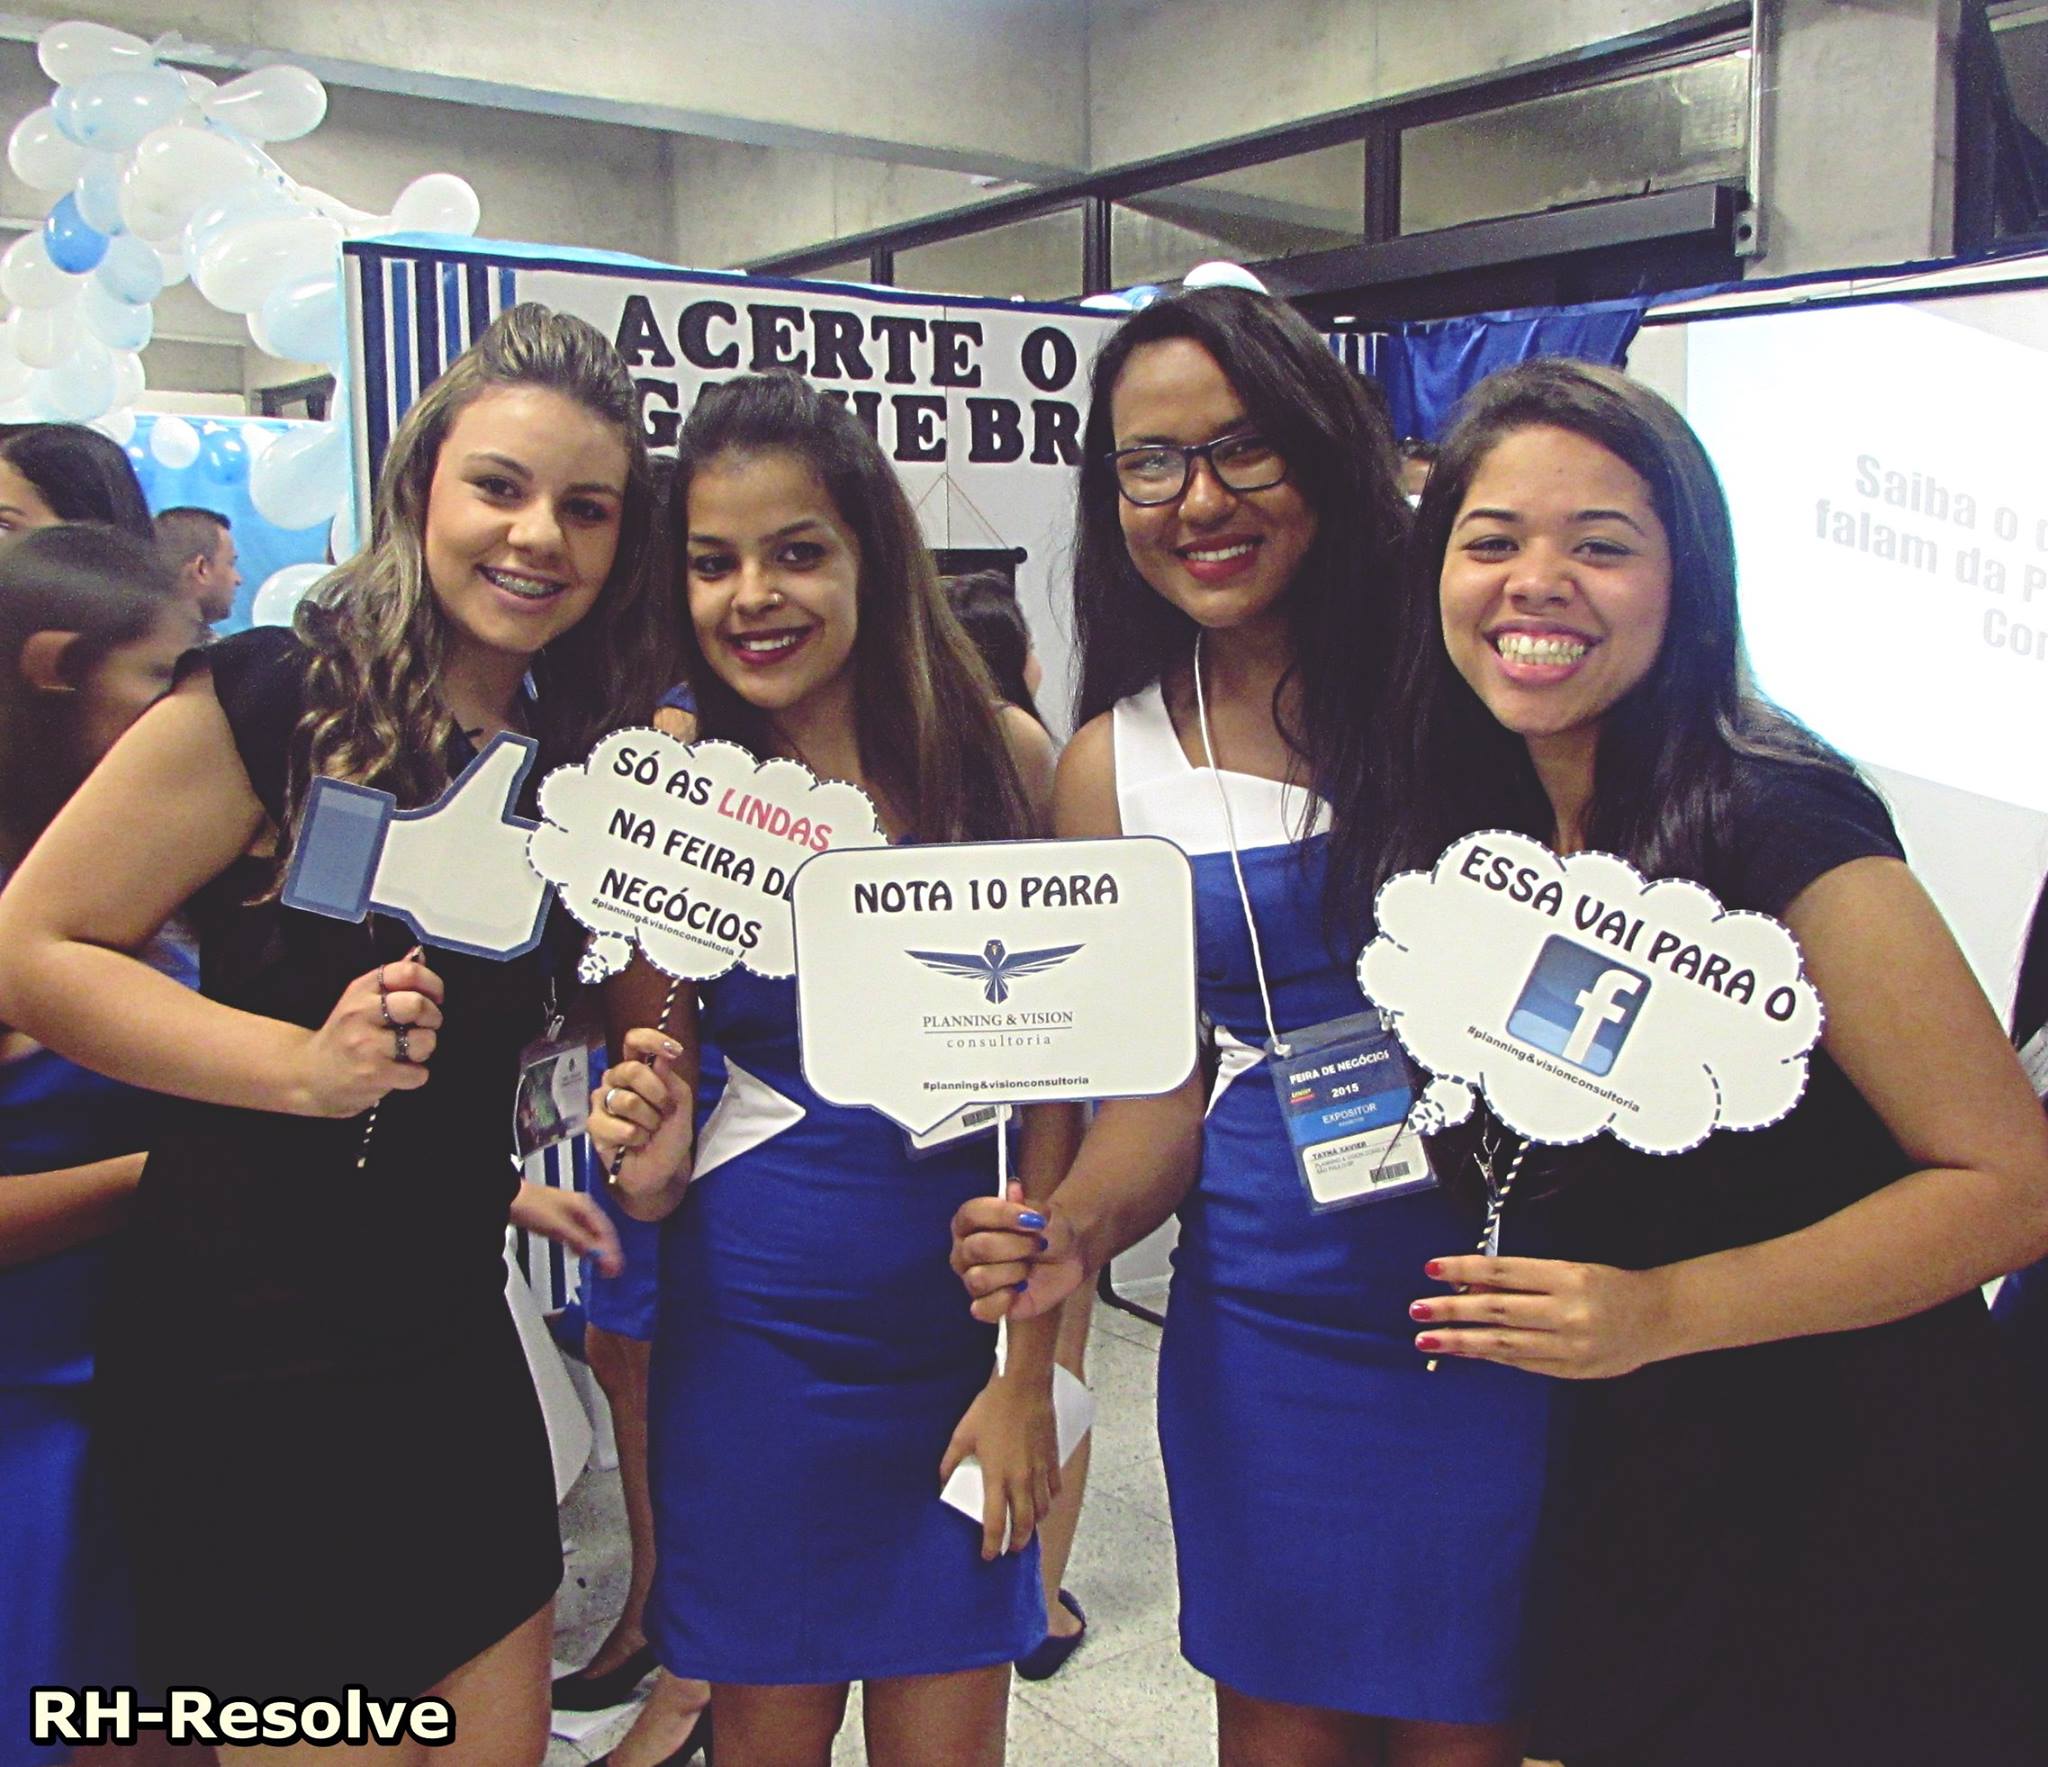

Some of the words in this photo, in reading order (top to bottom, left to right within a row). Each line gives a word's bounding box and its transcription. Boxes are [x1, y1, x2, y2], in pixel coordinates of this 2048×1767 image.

[615, 295, 984, 388] ACERTE
[1021, 326, 1078, 392] O
[1855, 453, 1977, 530] Saiba
[1994, 506, 2019, 543] o
[1815, 498, 1938, 575] falam
[1955, 547, 2007, 595] da
[613, 747, 661, 786] SÓ
[665, 769, 713, 806] AS
[716, 787, 833, 852] LINDAS
[608, 808, 656, 849] NA
[662, 828, 756, 887] FEIRA
[591, 897, 735, 957] #planning&visionconsultoria
[599, 867, 763, 950] NEGÓCIOS
[854, 879, 953, 914] NOTA
[968, 878, 1008, 911] 10
[1020, 873, 1119, 908] PARA
[1458, 844, 1565, 918] ESSA
[1574, 893, 1645, 952] VAI
[1647, 930, 1756, 1006] PARA
[1763, 985, 1797, 1023] O
[922, 1014, 1002, 1028] PLANNING
[1006, 1014, 1017, 1026] &
[1020, 1011, 1074, 1025] VISION
[946, 1035, 1052, 1049] consultoria
[922, 1076, 1090, 1092] #planning&visionconsultoria
[1289, 1069, 1320, 1084] FEIRA
[1321, 1064, 1336, 1076] DE
[1331, 1083, 1360, 1098] 2015
[1466, 1024, 1641, 1113] #planning&visionconsultoria
[1321, 1103, 1377, 1124] EXPOSITOR
